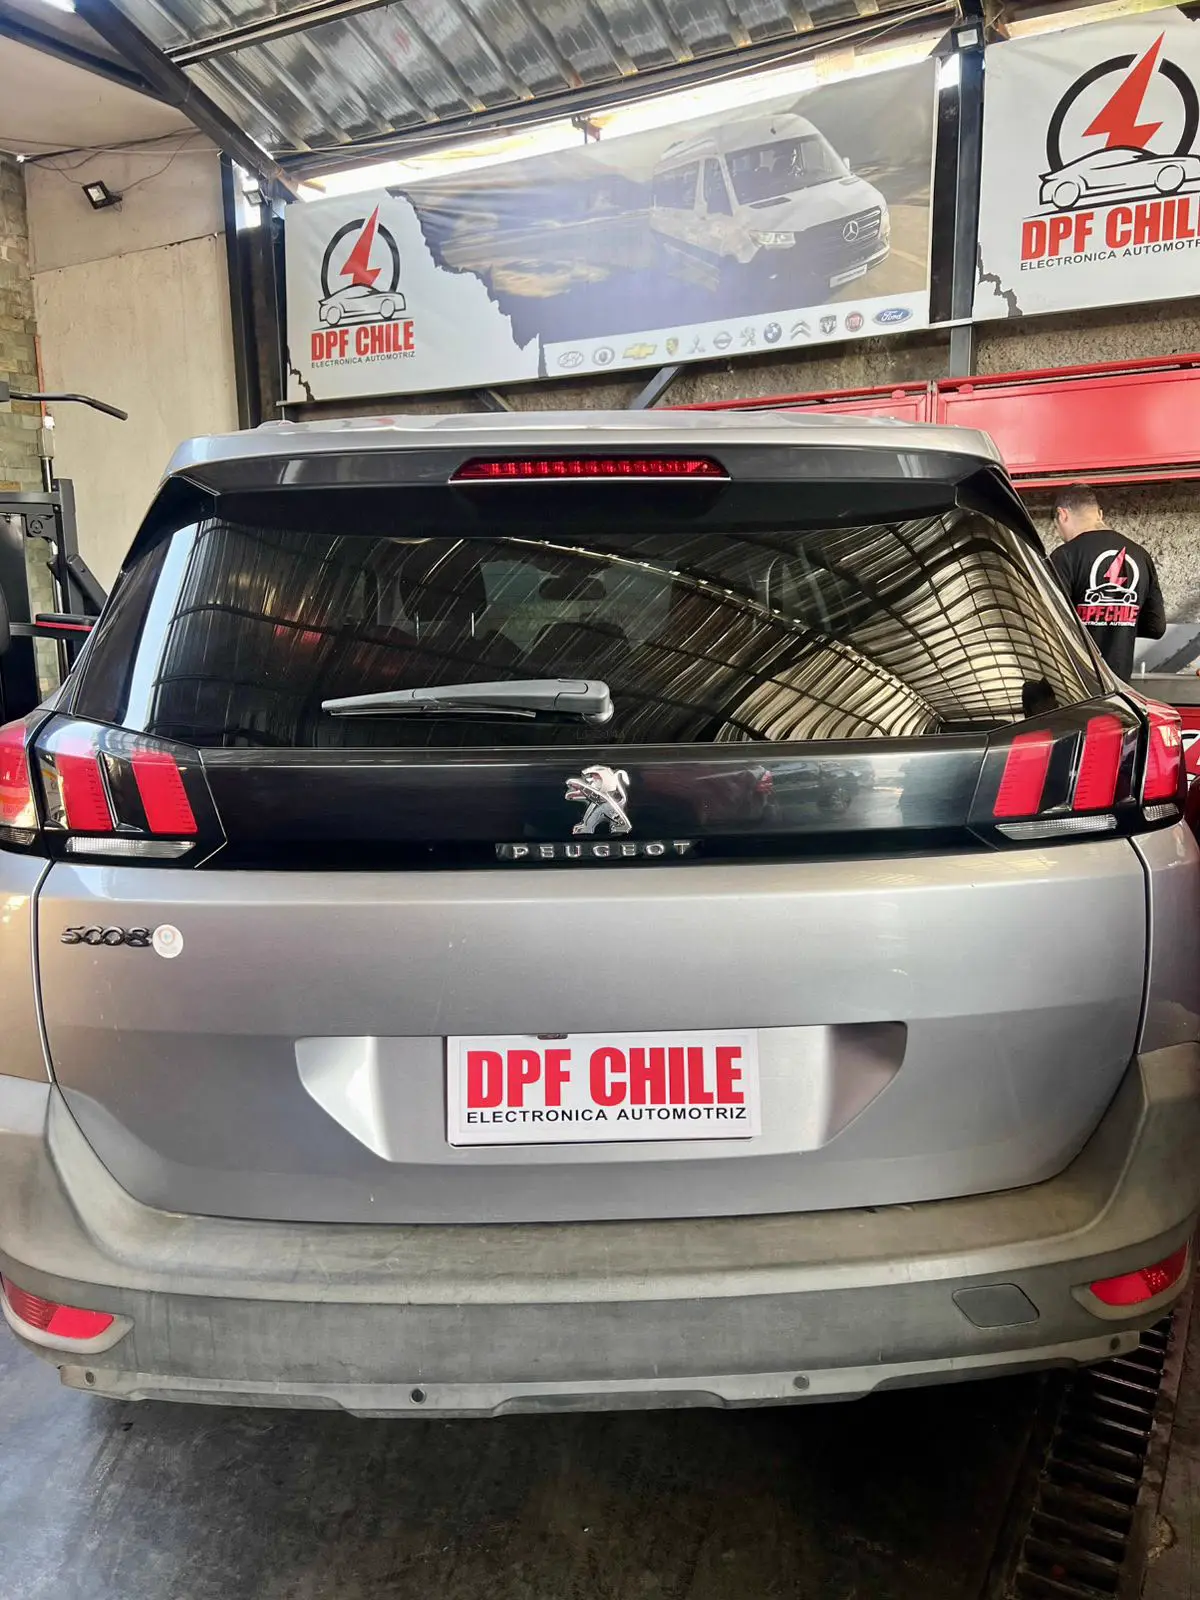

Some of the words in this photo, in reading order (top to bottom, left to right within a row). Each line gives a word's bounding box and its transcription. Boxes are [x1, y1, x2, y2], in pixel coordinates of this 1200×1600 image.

[1021, 211, 1094, 261] DPF
[1105, 197, 1200, 249] CHIL
[1020, 250, 1117, 271] ELECTRONICA
[880, 310, 904, 322] Ford
[311, 329, 349, 361] DPF
[355, 321, 415, 357] CHILE
[311, 357, 363, 369] ELECTRONICA
[365, 350, 416, 363] AUTOMOTRIZ
[512, 842, 690, 859] PEUGEOT
[60, 925, 153, 947] 5008
[467, 1048, 572, 1108] DPF
[589, 1046, 745, 1107] CHILE
[466, 1108, 608, 1124] ELECTRONICA
[616, 1106, 748, 1120] AUTOMOTRIZ
